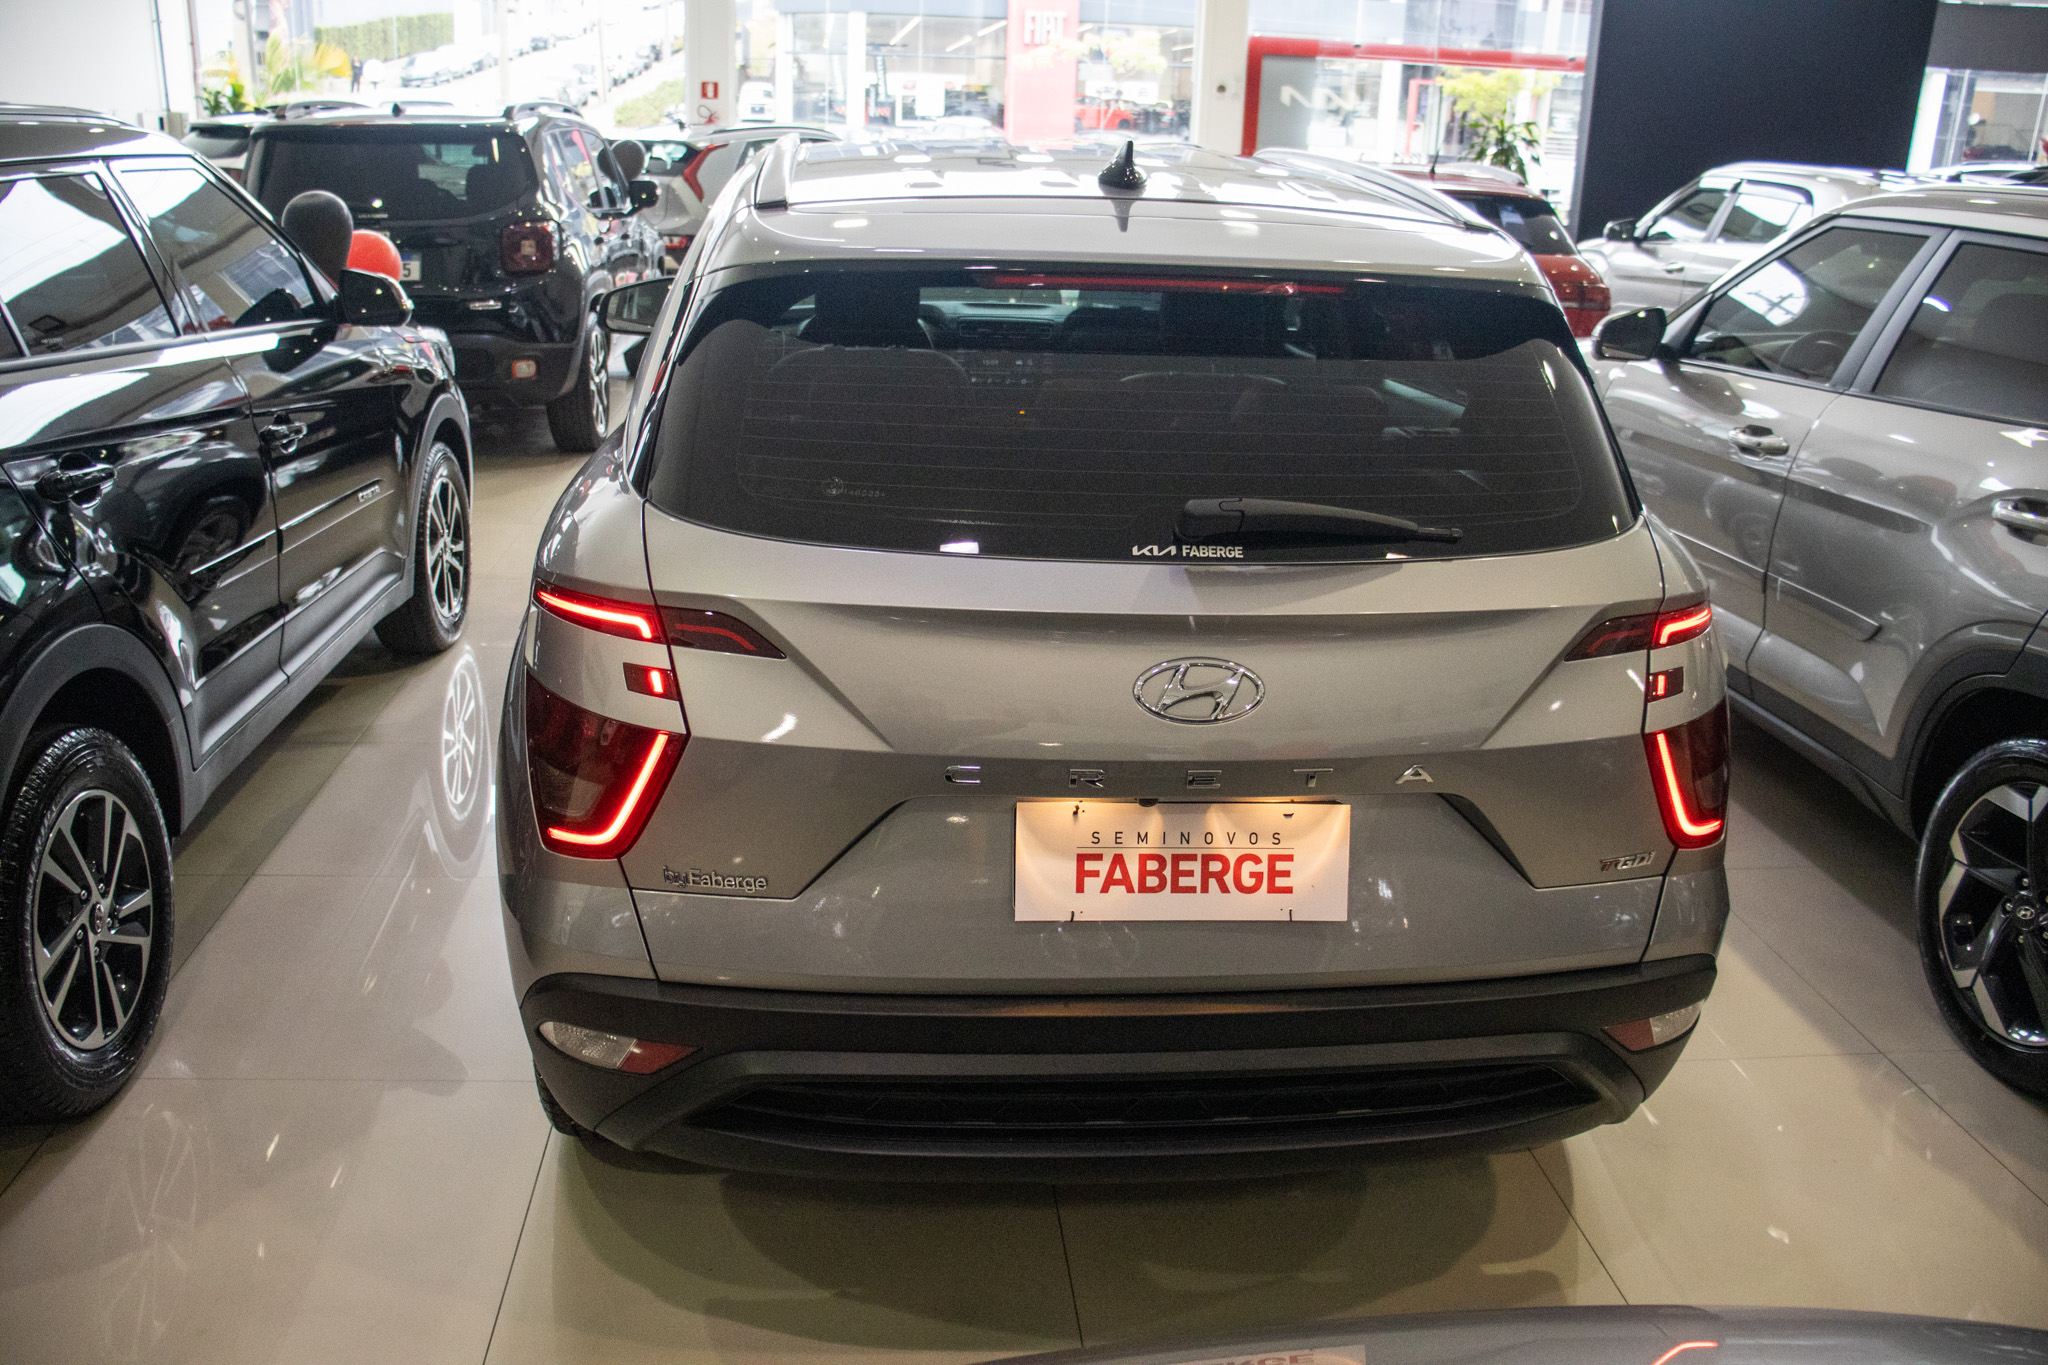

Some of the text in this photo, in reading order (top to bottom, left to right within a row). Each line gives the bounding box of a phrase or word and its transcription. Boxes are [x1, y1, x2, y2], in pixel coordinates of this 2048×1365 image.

[1024, 11, 1067, 45] FIAT
[1132, 545, 1244, 558] KIA FABERGE
[944, 765, 1434, 789] CRETA
[1091, 831, 1281, 845] SEMINOVOS
[663, 866, 767, 893] by Faberge
[1075, 853, 1294, 895] FABERGE
